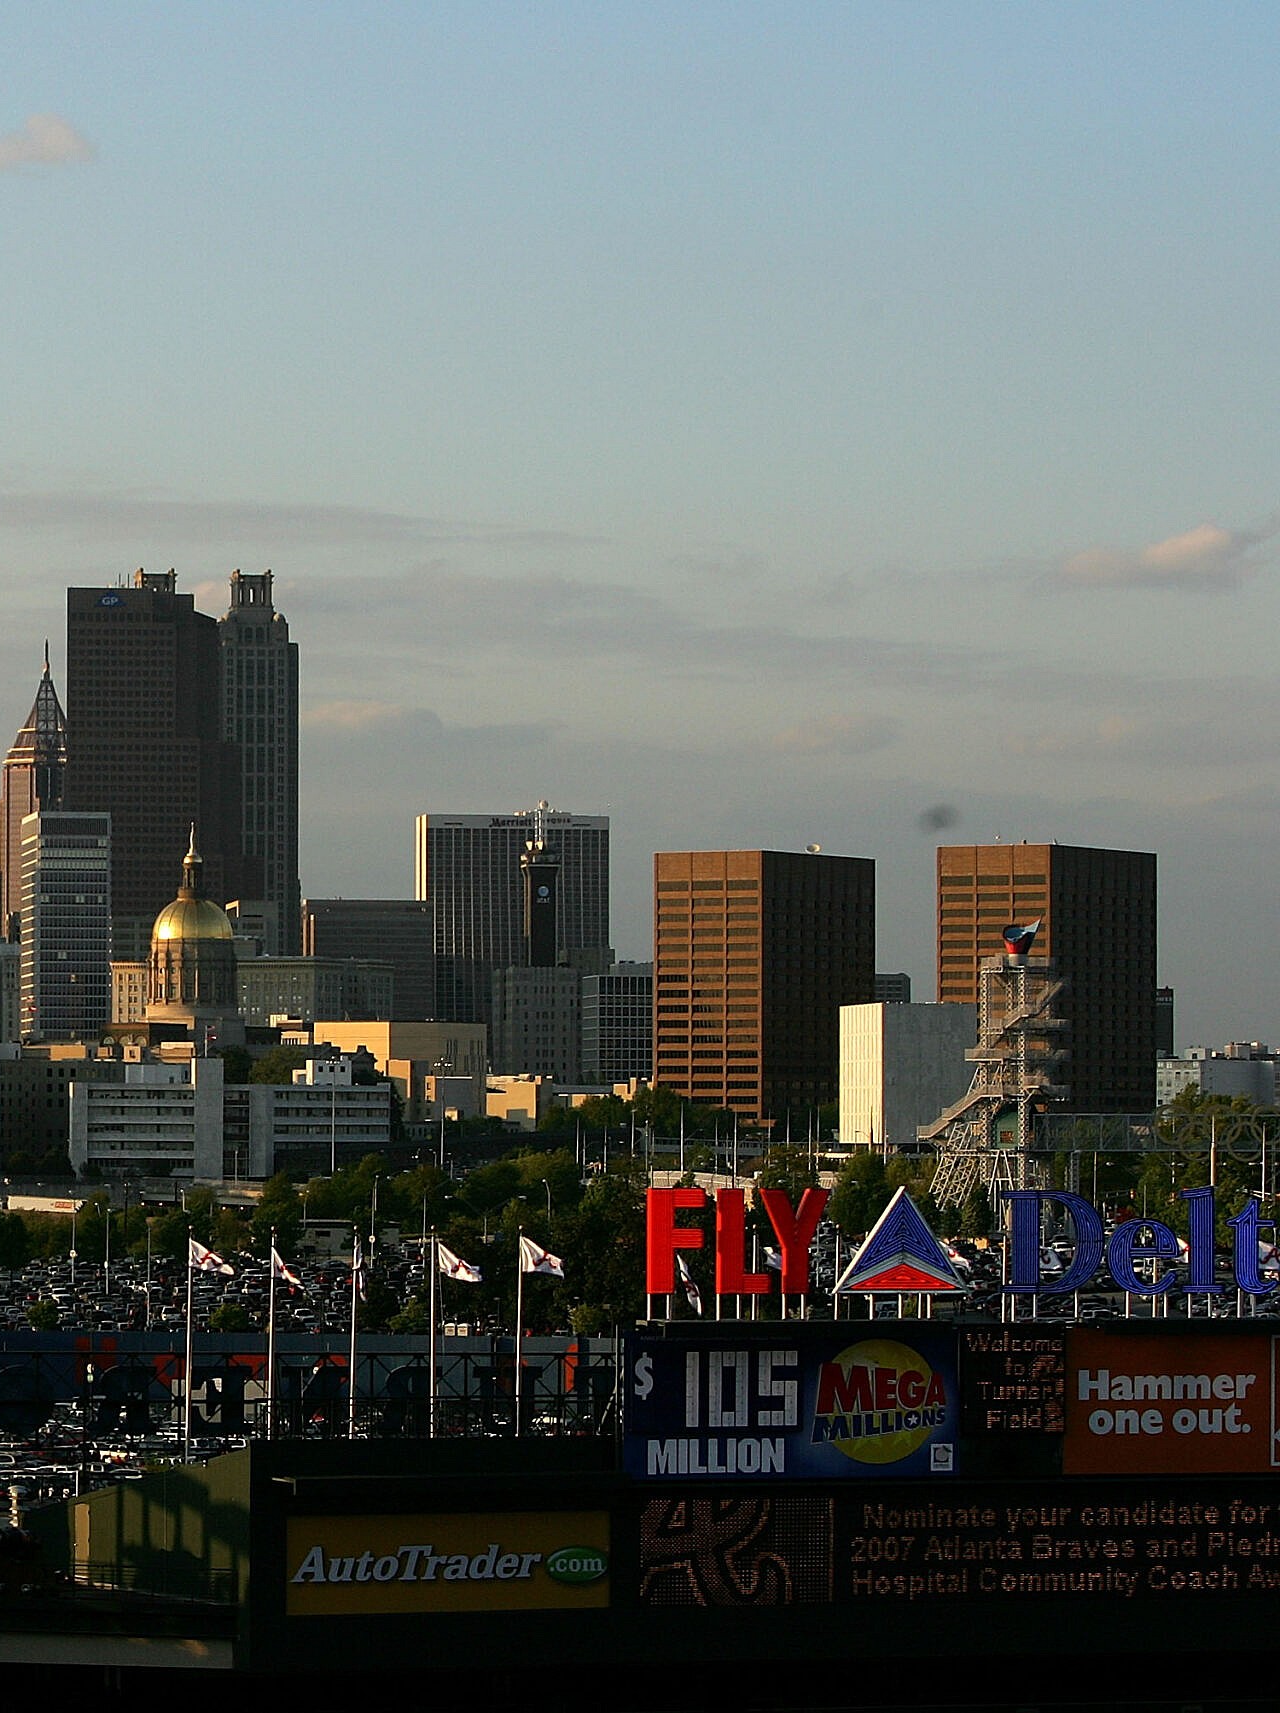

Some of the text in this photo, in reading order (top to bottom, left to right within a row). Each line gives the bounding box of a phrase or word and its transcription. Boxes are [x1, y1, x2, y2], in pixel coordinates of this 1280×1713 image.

[101, 596, 118, 606] GP
[489, 816, 533, 829] Marriott
[646, 1187, 828, 1295] FLY
[965, 1331, 1063, 1352] Welcome
[1003, 1357, 1025, 1376] to
[685, 1350, 798, 1427] 105
[815, 1361, 946, 1415] MEGA
[976, 1381, 1054, 1400] Turner
[1077, 1368, 1256, 1400] Hammer
[811, 1407, 946, 1445] MILLIONS
[985, 1408, 1042, 1430] Field
[1088, 1402, 1252, 1435] one out.
[647, 1438, 785, 1475] MILLION
[863, 1498, 1271, 1535] Nominate your candidate for
[289, 1544, 544, 1583] AutoTrader
[850, 1536, 916, 1563] 2007
[923, 1534, 1024, 1561] Atlanta
[1031, 1534, 1137, 1560] Braves
[1144, 1531, 1201, 1558] and
[851, 1568, 970, 1600] Hospital
[977, 1566, 1140, 1599] Community
[1147, 1563, 1241, 1591] Coach
